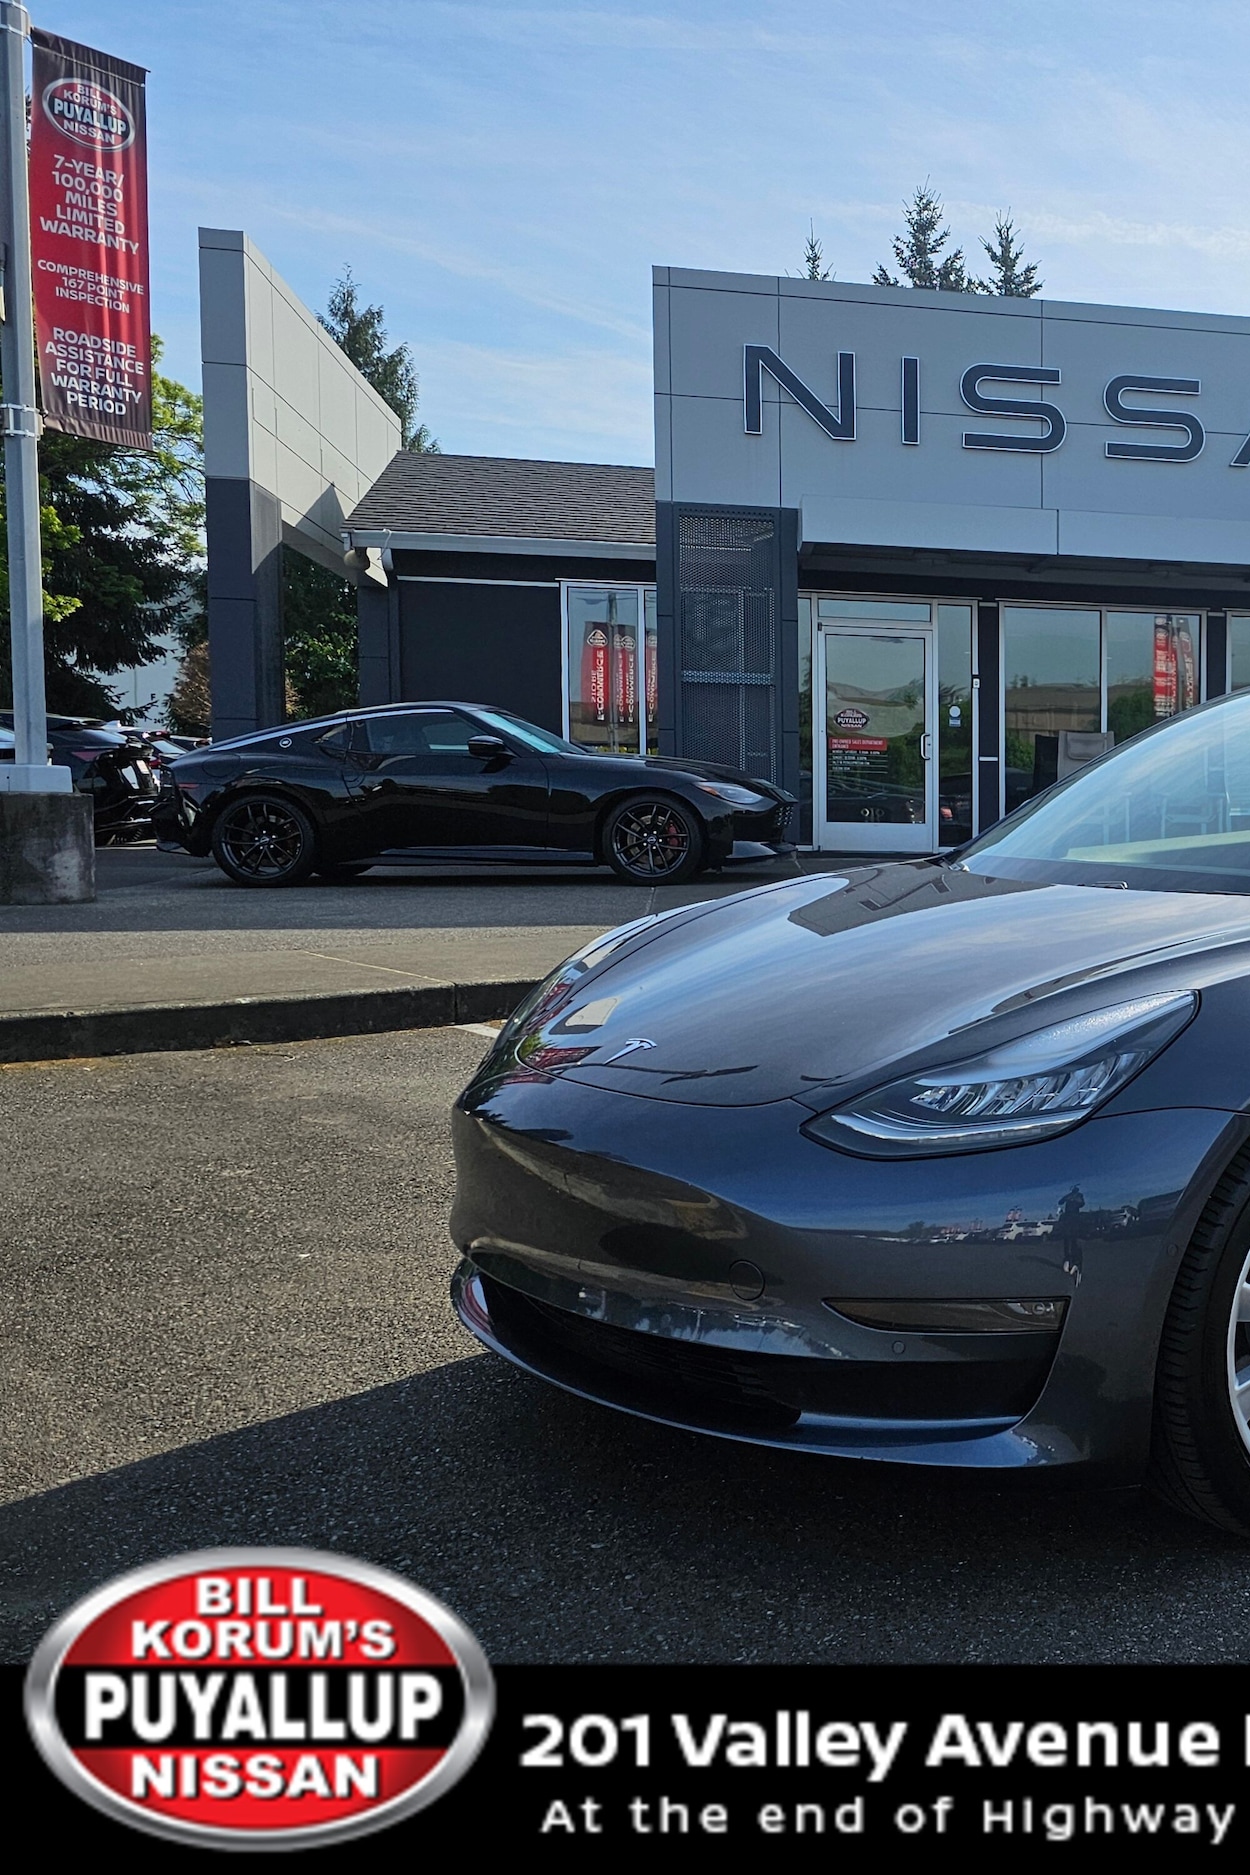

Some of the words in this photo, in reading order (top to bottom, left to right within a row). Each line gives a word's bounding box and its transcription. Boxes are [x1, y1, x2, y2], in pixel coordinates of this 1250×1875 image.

[64, 90, 117, 116] KORUM'S
[77, 84, 102, 100] BILL
[54, 98, 126, 135] PUYALLUP
[63, 120, 114, 144] NISSAN
[54, 154, 124, 188] 7-YEAR/
[52, 171, 123, 203] 100,000
[65, 190, 118, 217] MILES
[56, 204, 125, 234] LIMITED
[40, 216, 139, 254] WARRANTY
[38, 260, 144, 295] COMPREHENSIVE
[62, 277, 84, 289] 167
[88, 283, 125, 300] POINT
[56, 286, 130, 313] INSPECTION
[53, 327, 136, 358] ROADSIDE
[45, 341, 144, 375] ASSISTANCE
[56, 358, 92, 378] FOR
[96, 367, 132, 387] FULL
[51, 372, 142, 404] WARRANTY
[67, 391, 126, 415] PERIOD
